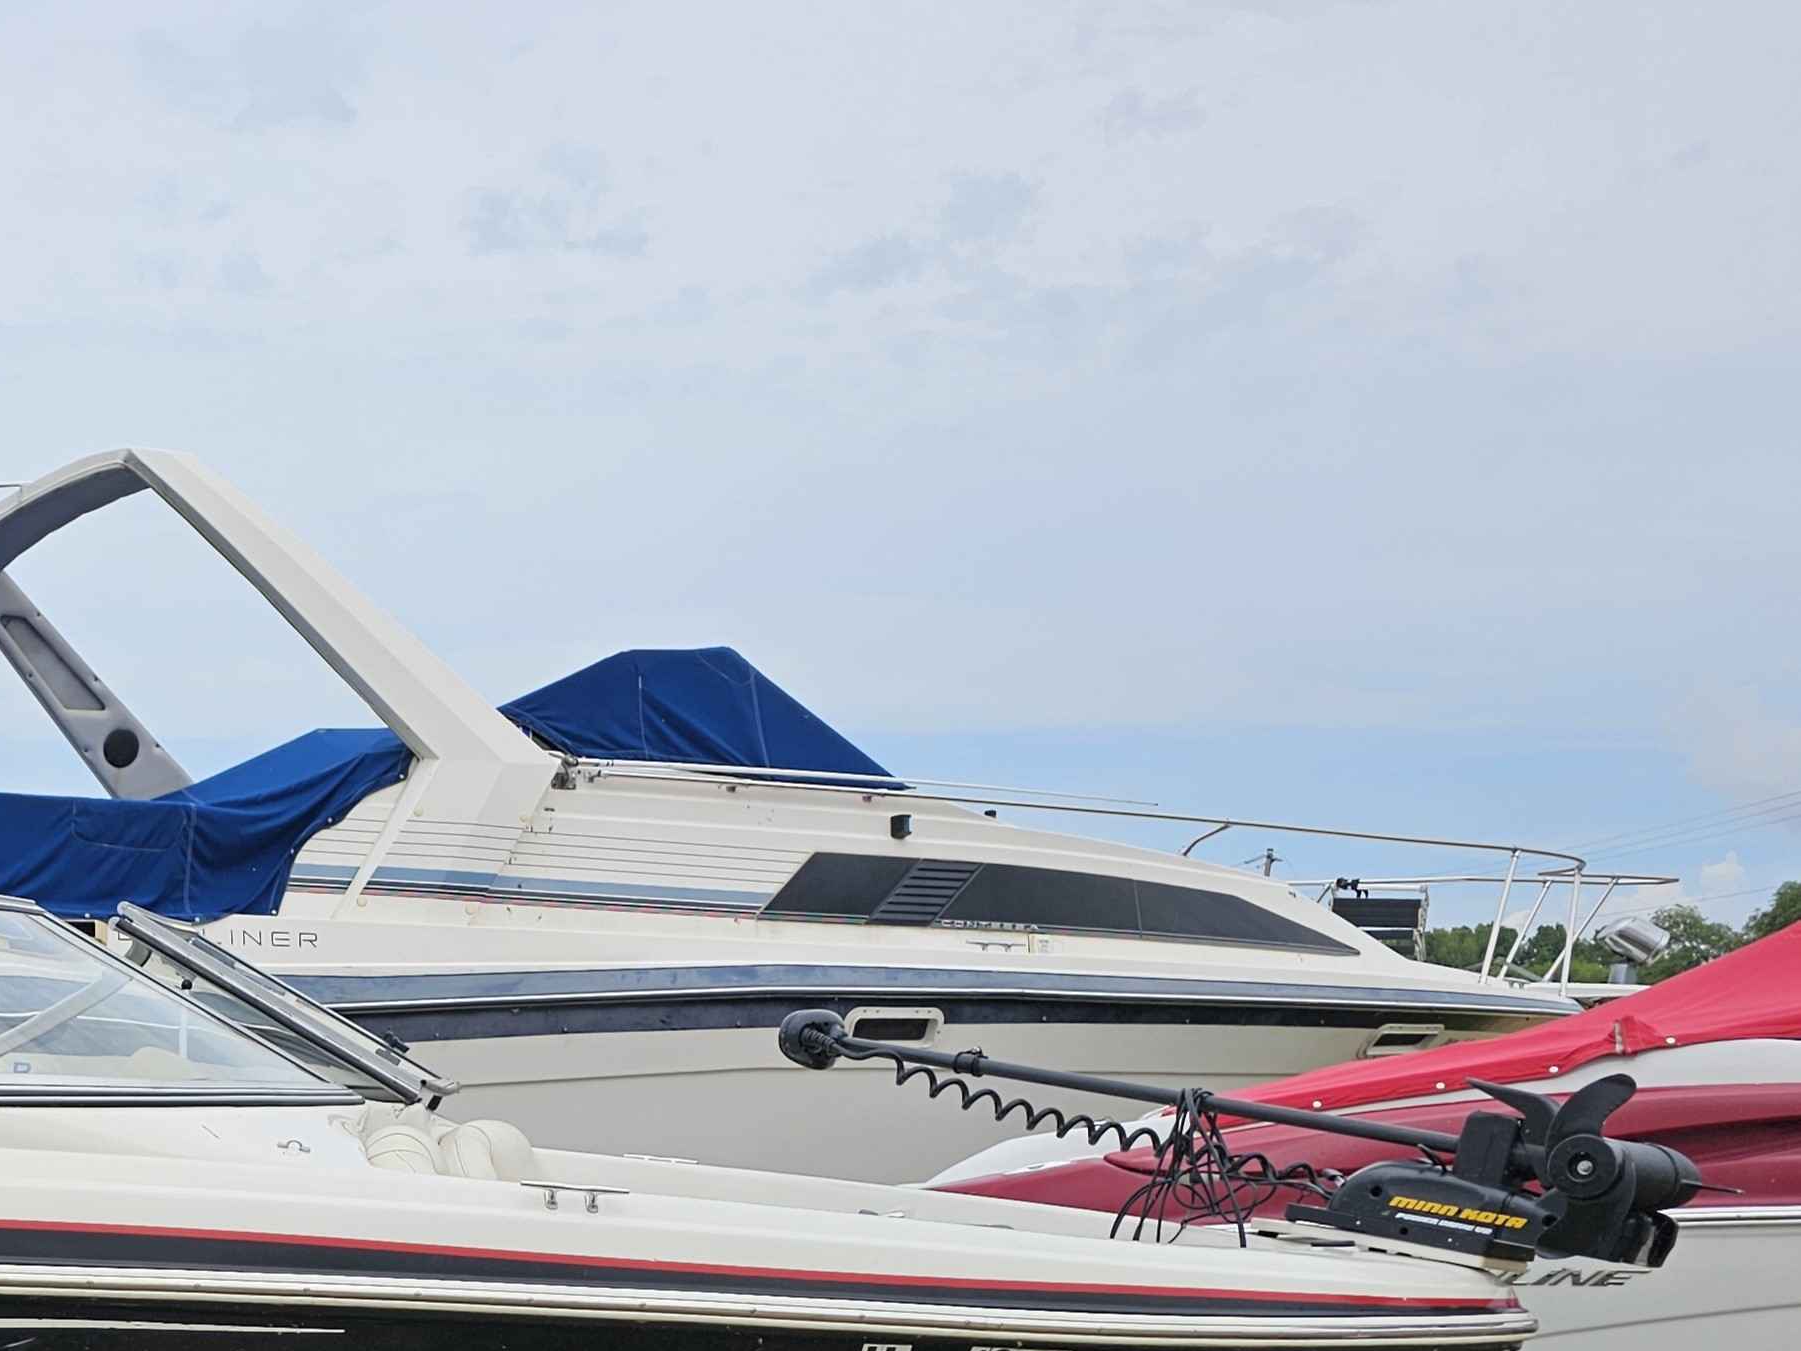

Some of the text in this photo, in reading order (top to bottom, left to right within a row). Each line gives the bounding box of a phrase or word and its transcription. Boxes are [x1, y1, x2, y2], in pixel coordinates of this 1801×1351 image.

[1389, 1195, 1529, 1229] MINN KOTA
[1498, 1268, 1653, 1287] LINE
